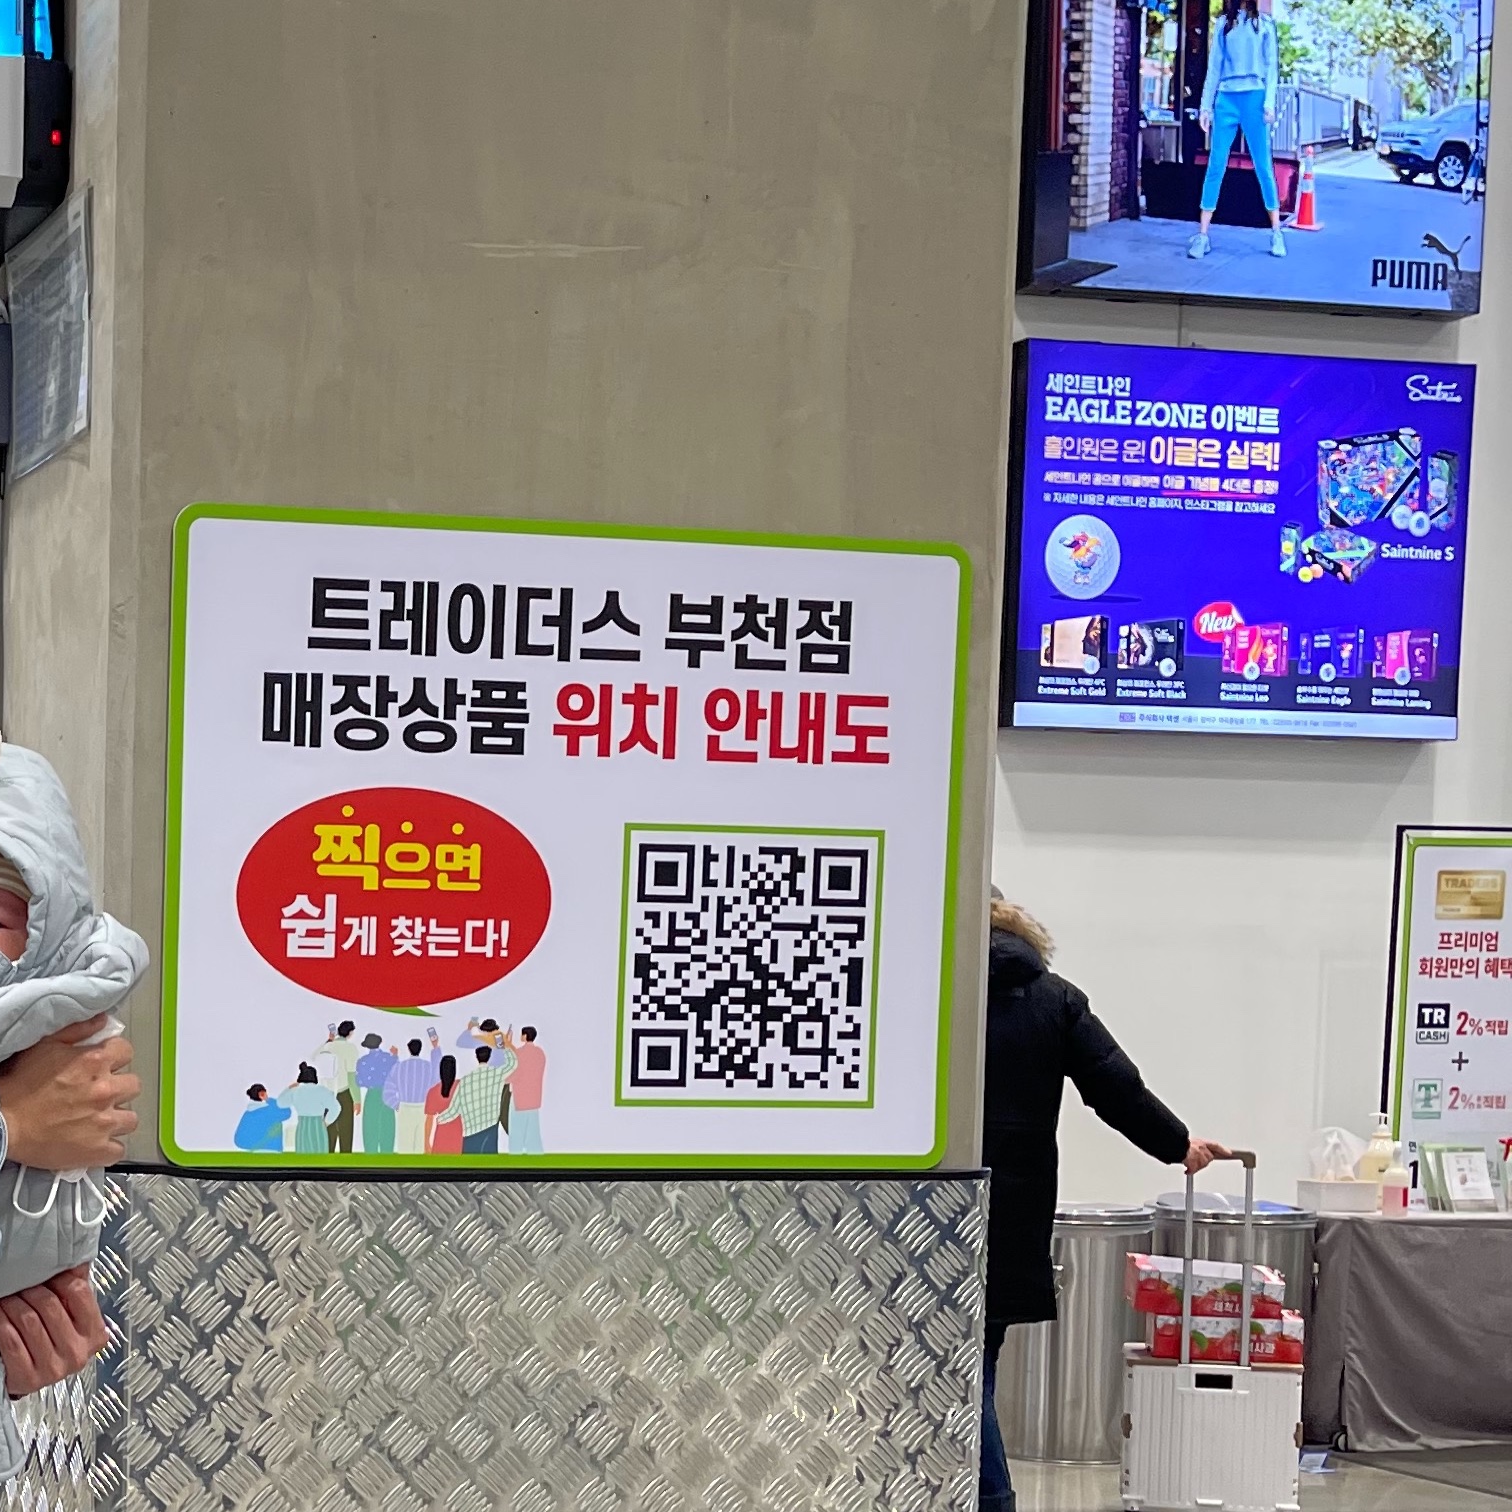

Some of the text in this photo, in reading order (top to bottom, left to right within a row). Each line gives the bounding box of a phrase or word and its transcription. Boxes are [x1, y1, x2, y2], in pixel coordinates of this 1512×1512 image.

[1371, 258, 1448, 291] PUMA
[1045, 373, 1131, 397] 세인트나인
[1045, 395, 1280, 434] EAGLE ZONE 이벤트
[1043, 436, 1119, 462] 홀인원은
[1150, 436, 1221, 468] 이글은
[1226, 440, 1280, 471] 실력!
[1162, 474, 1185, 490] 이글
[1053, 492, 1078, 504] 자세한
[1106, 495, 1148, 508] 세인트나인
[1381, 543, 1455, 562] Saintnine S
[306, 576, 854, 675] 트레이더스 부천점
[1199, 610, 1235, 633] New
[261, 671, 891, 765] 매장상품 위치 안내도
[311, 820, 483, 892] 찍으면
[280, 892, 511, 960] 쉽게 찾는다!
[1438, 931, 1499, 953] 프리미엄
[1418, 957, 1512, 979] 회원만의 혜택
[1421, 1007, 1446, 1024] TR
[1418, 1030, 1446, 1042] CASH
